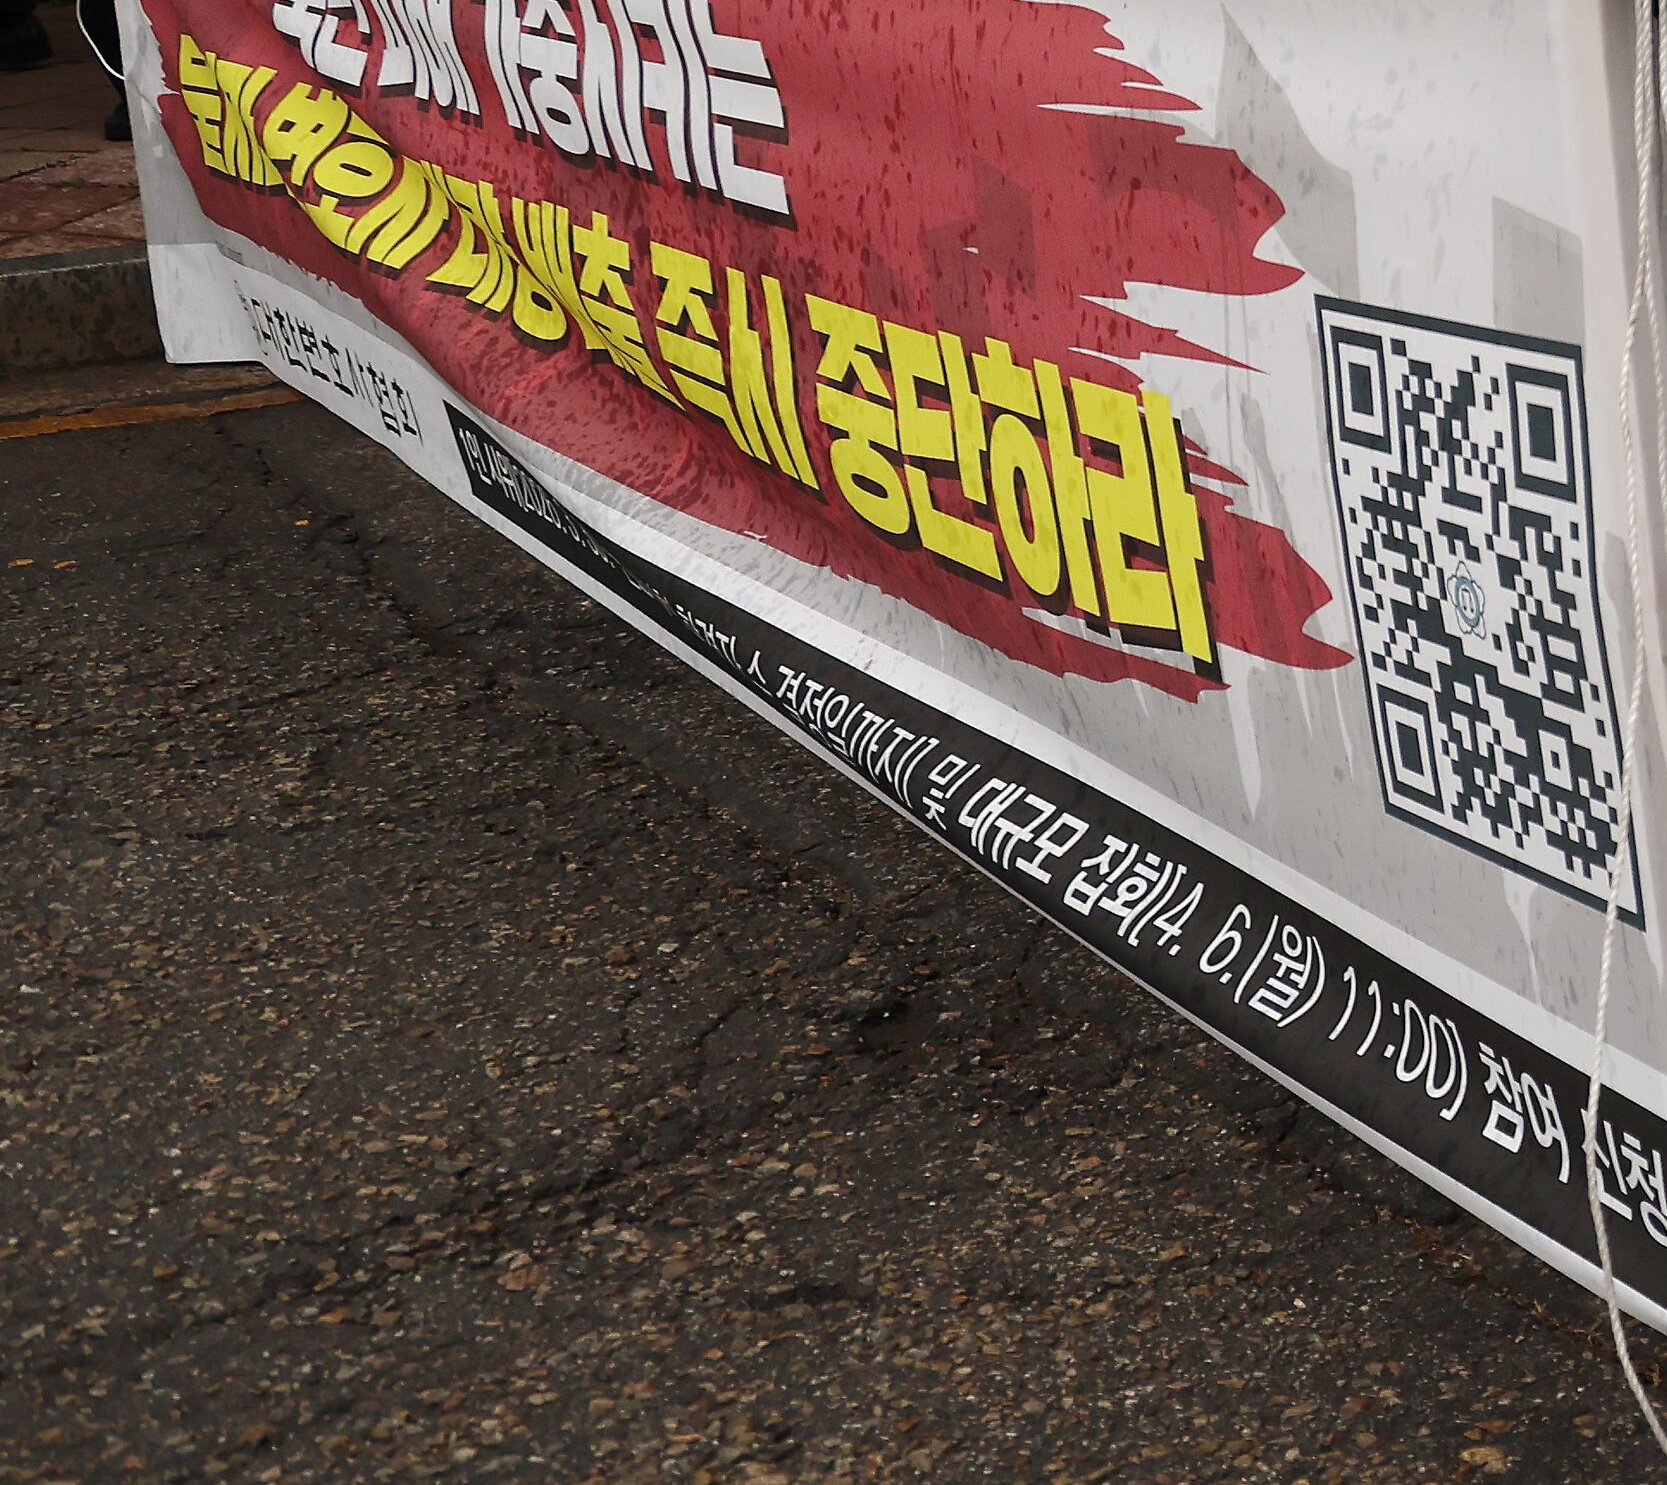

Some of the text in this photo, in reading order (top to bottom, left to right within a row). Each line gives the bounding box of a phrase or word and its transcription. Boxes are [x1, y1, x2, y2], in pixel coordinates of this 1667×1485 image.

[650, 239, 819, 490] 즉시
[805, 293, 1213, 663] 중단하라
[922, 755, 980, 831] 및
[959, 777, 1090, 884] 대규모
[1478, 1041, 1570, 1184] 참여
